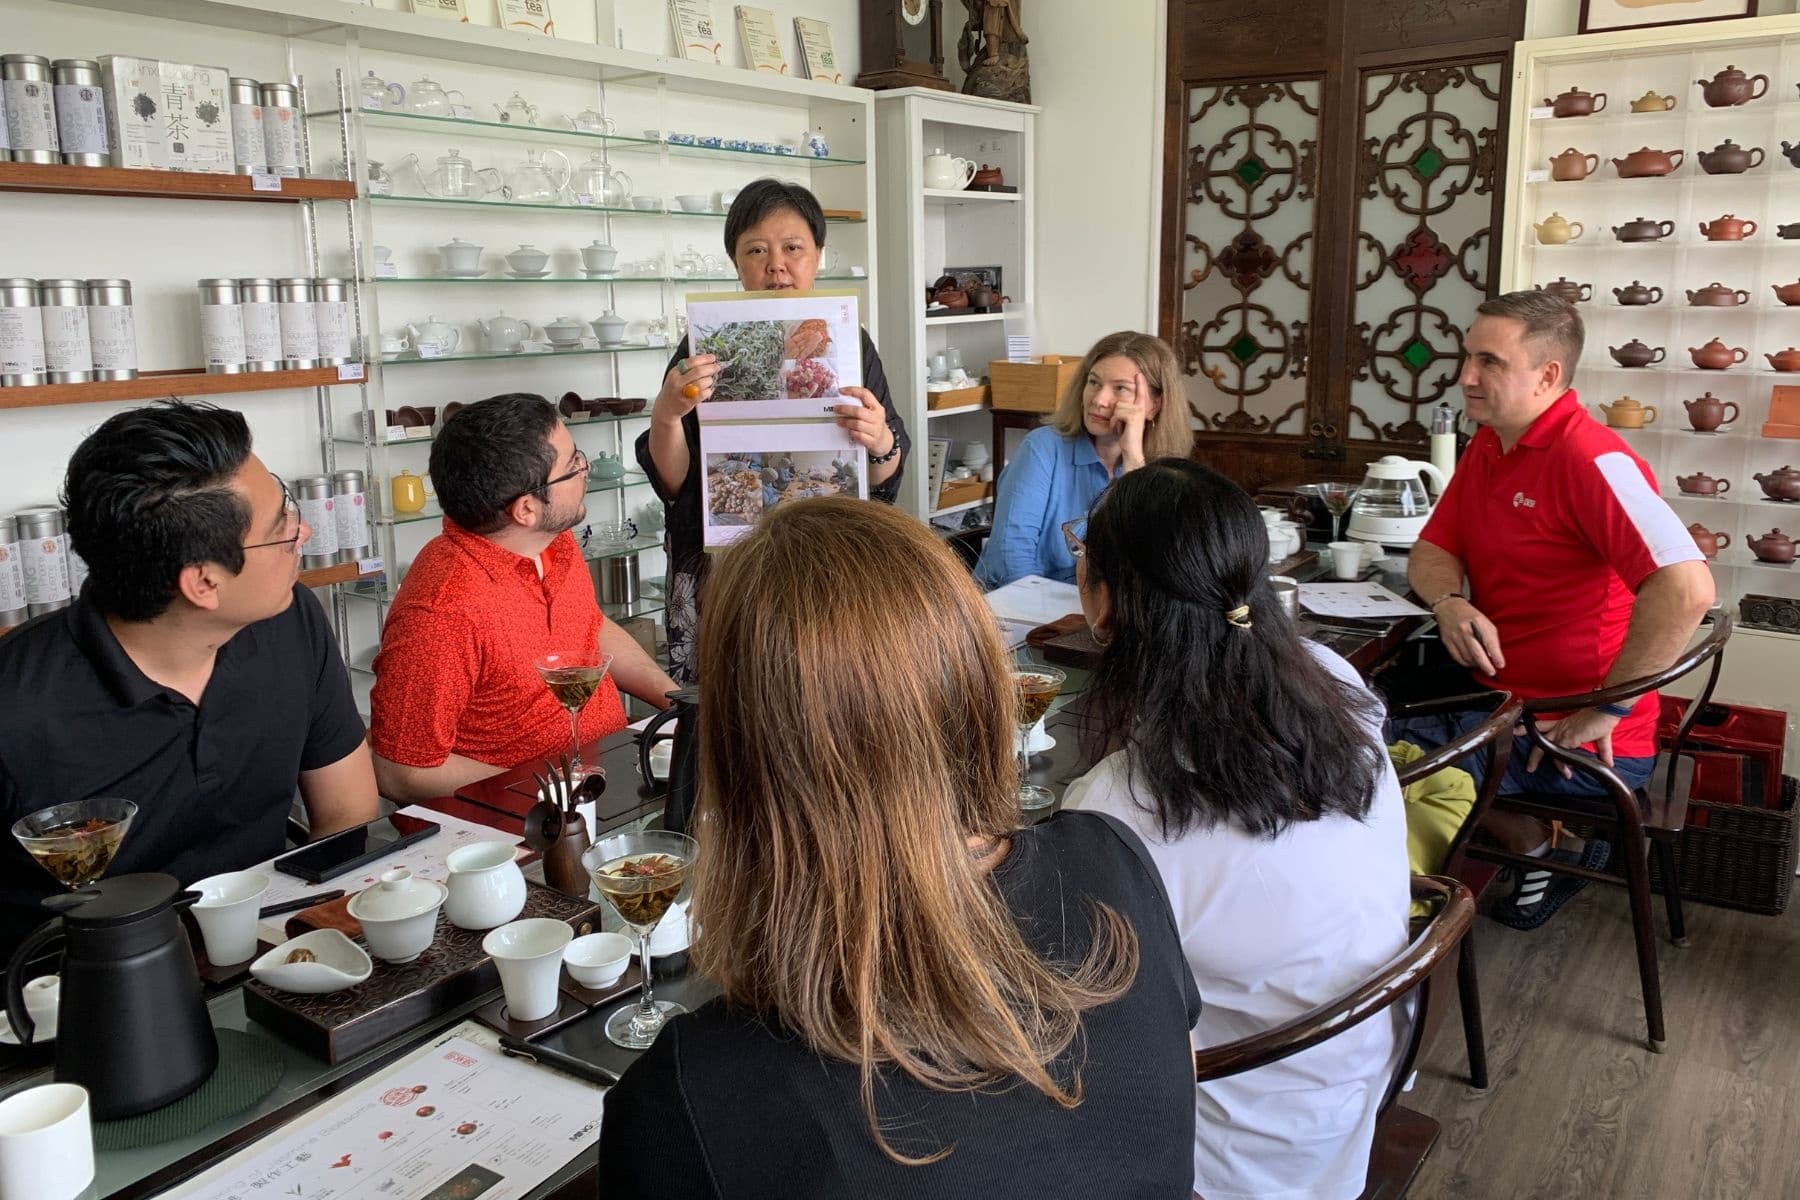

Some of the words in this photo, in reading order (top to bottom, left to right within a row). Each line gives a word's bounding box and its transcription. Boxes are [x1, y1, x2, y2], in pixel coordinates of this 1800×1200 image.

[525, 1, 543, 12] tea
[697, 23, 712, 35] tea
[160, 82, 190, 140] 青茶
